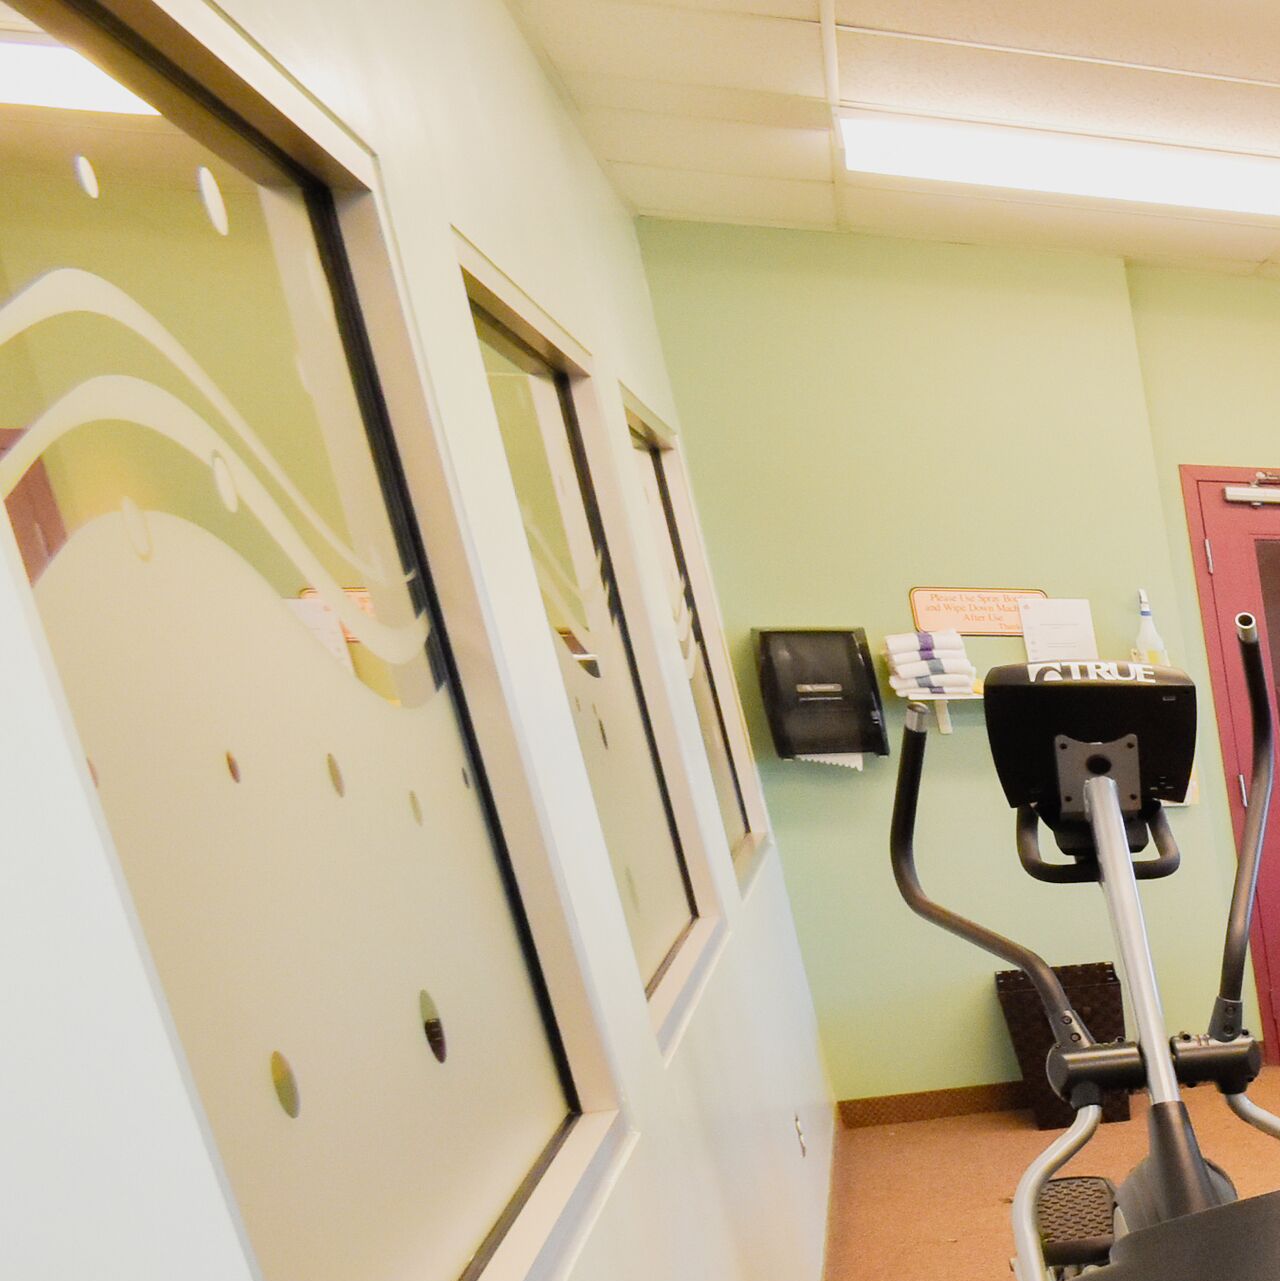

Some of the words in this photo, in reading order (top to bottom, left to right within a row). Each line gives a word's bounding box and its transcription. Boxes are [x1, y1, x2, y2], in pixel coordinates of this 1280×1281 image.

[929, 593, 957, 602] Please
[960, 593, 976, 602] Use
[1002, 594, 1019, 602] Bot
[926, 603, 941, 612] and
[943, 603, 966, 613] Wipe
[968, 603, 994, 612] Down
[963, 613, 985, 622] After
[987, 614, 1004, 622] Use
[1060, 661, 1157, 684] TRUE
